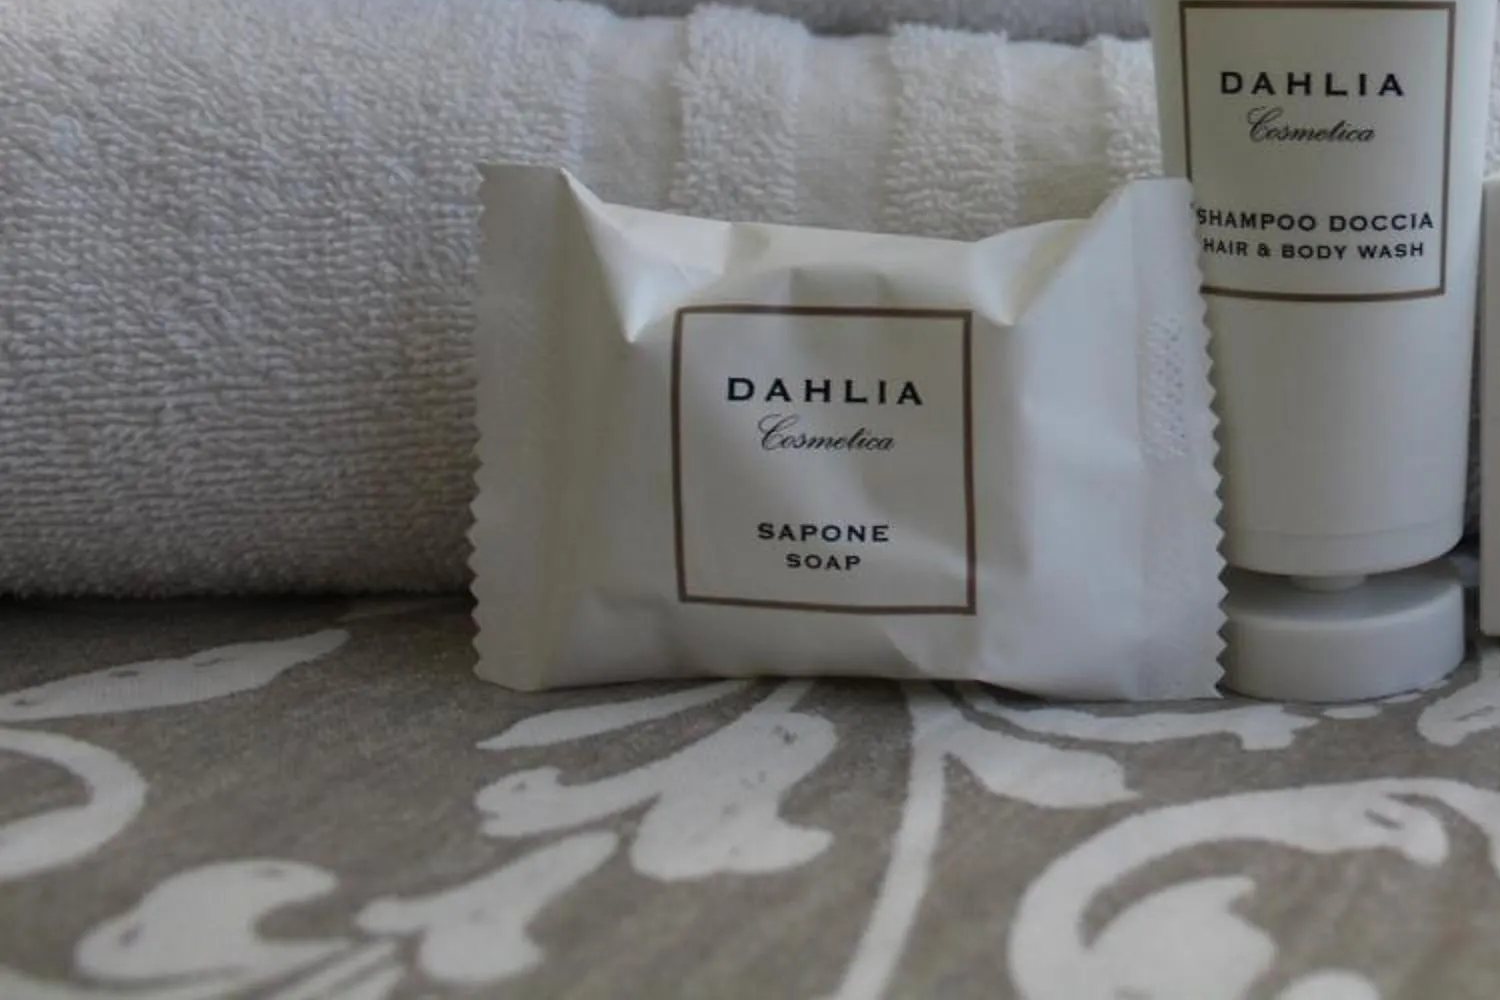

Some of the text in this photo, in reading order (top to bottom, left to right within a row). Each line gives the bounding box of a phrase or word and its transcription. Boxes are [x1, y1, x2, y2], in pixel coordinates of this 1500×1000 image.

[1220, 71, 1405, 96] DAHLIA
[1247, 105, 1376, 143] Cosmetica
[1196, 207, 1434, 232] SHAMPOO DOCCIA
[1203, 238, 1424, 260] HAIR & BODY WASH
[727, 377, 923, 405] DAHLIA
[757, 414, 895, 451] Cosmetica
[757, 523, 889, 543] SAPONE
[786, 553, 861, 571] SOAP
